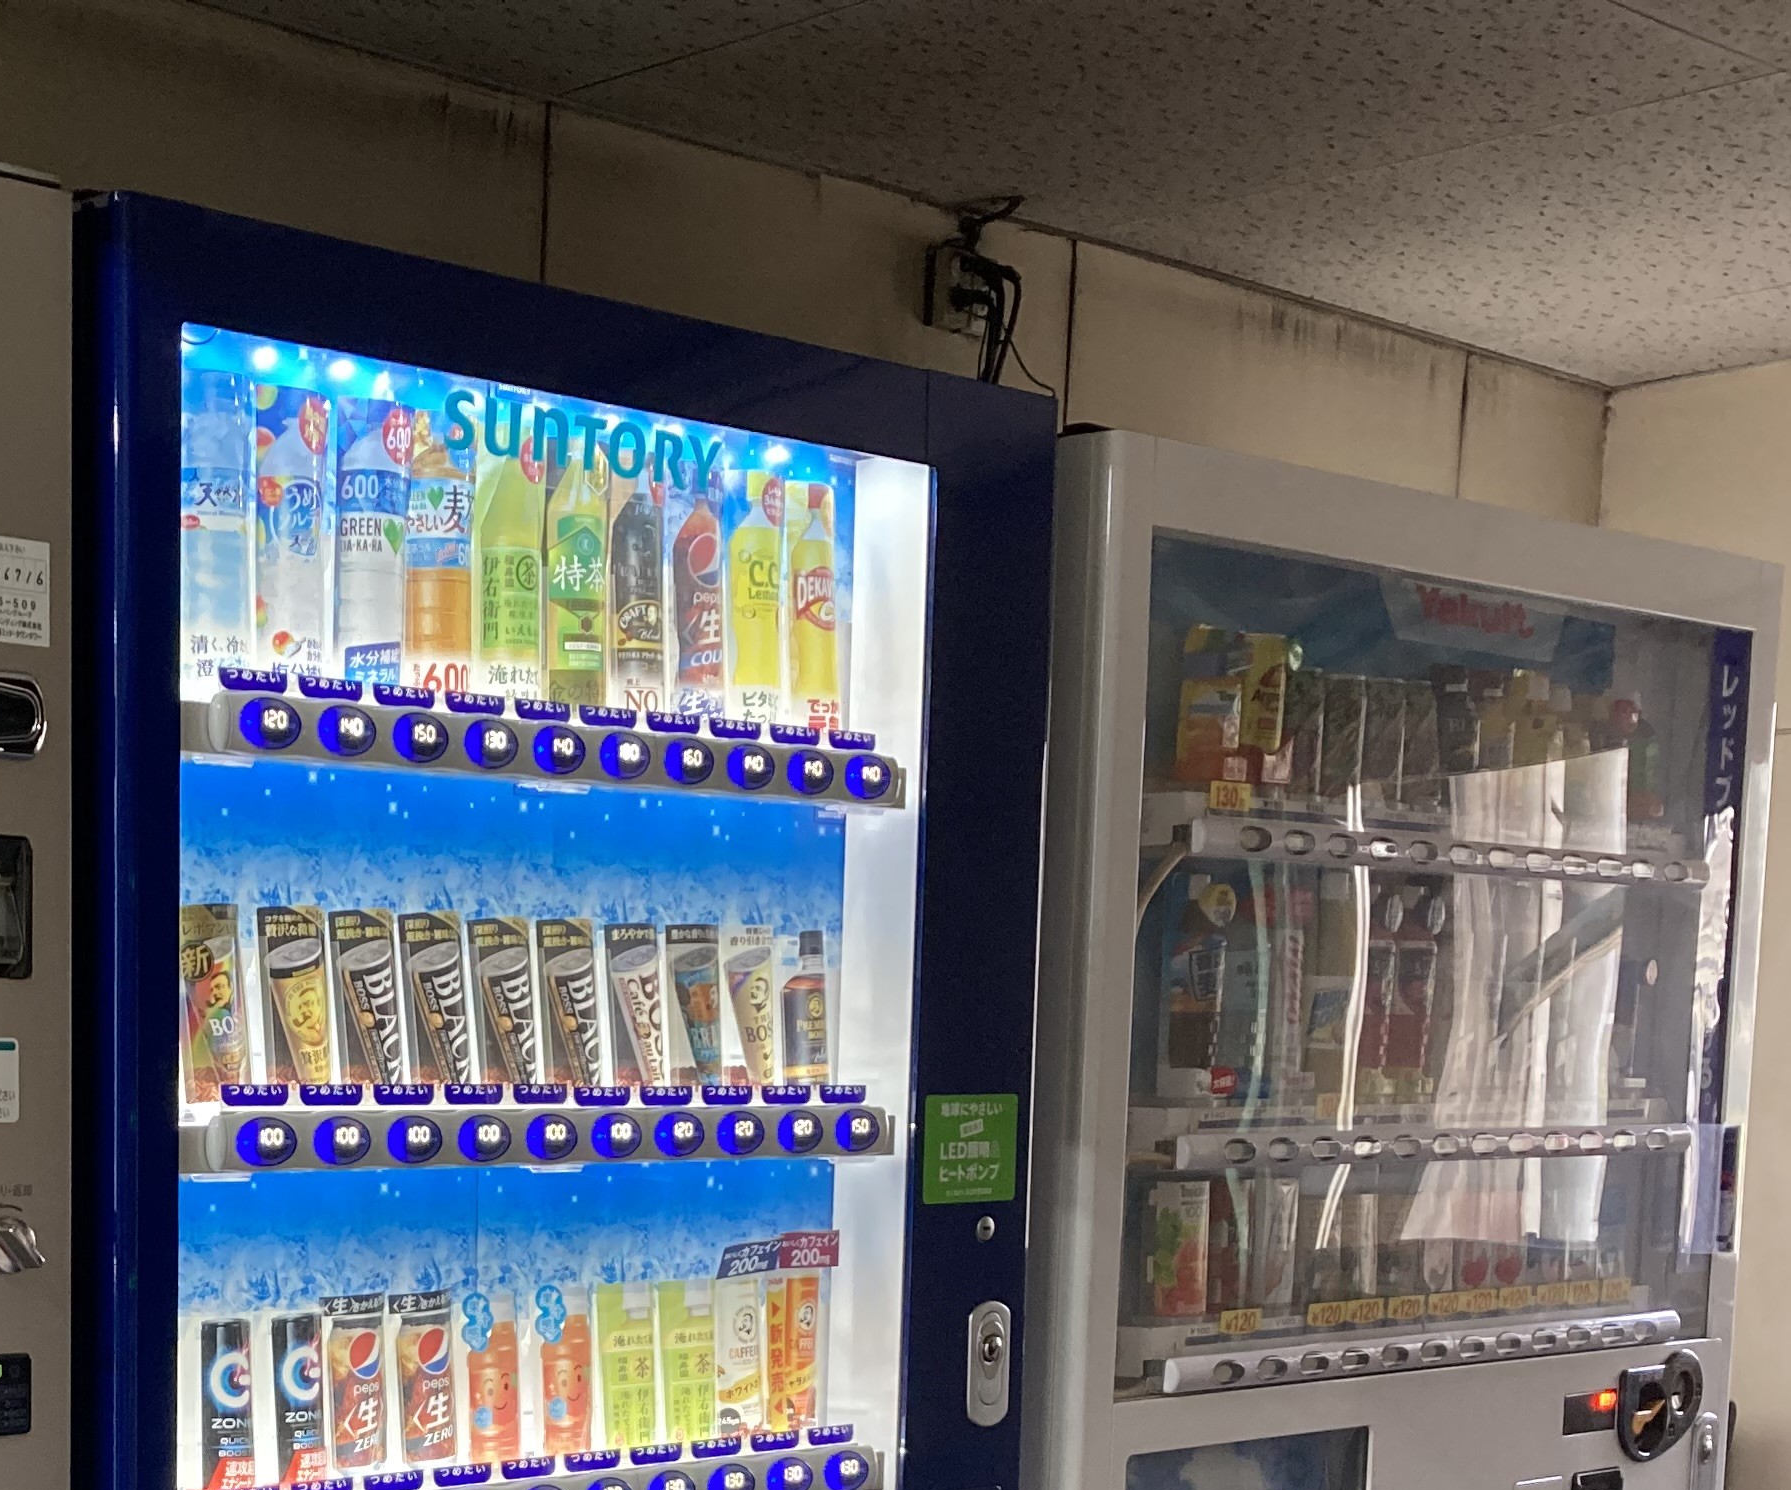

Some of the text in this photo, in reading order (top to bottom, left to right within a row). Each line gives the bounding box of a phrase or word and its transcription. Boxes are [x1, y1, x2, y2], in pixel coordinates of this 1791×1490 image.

[444, 388, 724, 490] SUNTORY
[341, 475, 379, 499] 600
[341, 517, 382, 537] GREEN
[552, 554, 605, 593] 特茶
[482, 556, 501, 641] 伊右衛門
[226, 667, 872, 743] つめたい つめたい つめたい つめたい つめたい つめたい つめたい つめたい つめたい つめたい
[263, 709, 287, 729] 120
[414, 723, 437, 743] 150
[485, 730, 506, 748] 130
[939, 1162, 1000, 1183] ヒートポンプ
[1225, 1312, 1256, 1332] ¥120
[1312, 1304, 1341, 1323] ¥120
[1350, 1301, 1379, 1320] ¥120
[770, 1322, 785, 1393] 新発売
[354, 1380, 379, 1397] peps
[423, 1377, 449, 1393] peps
[423, 1426, 453, 1447] ZERO
[724, 1472, 744, 1488] 130
[784, 1465, 803, 1481] 130
[840, 1458, 859, 1475] 130
